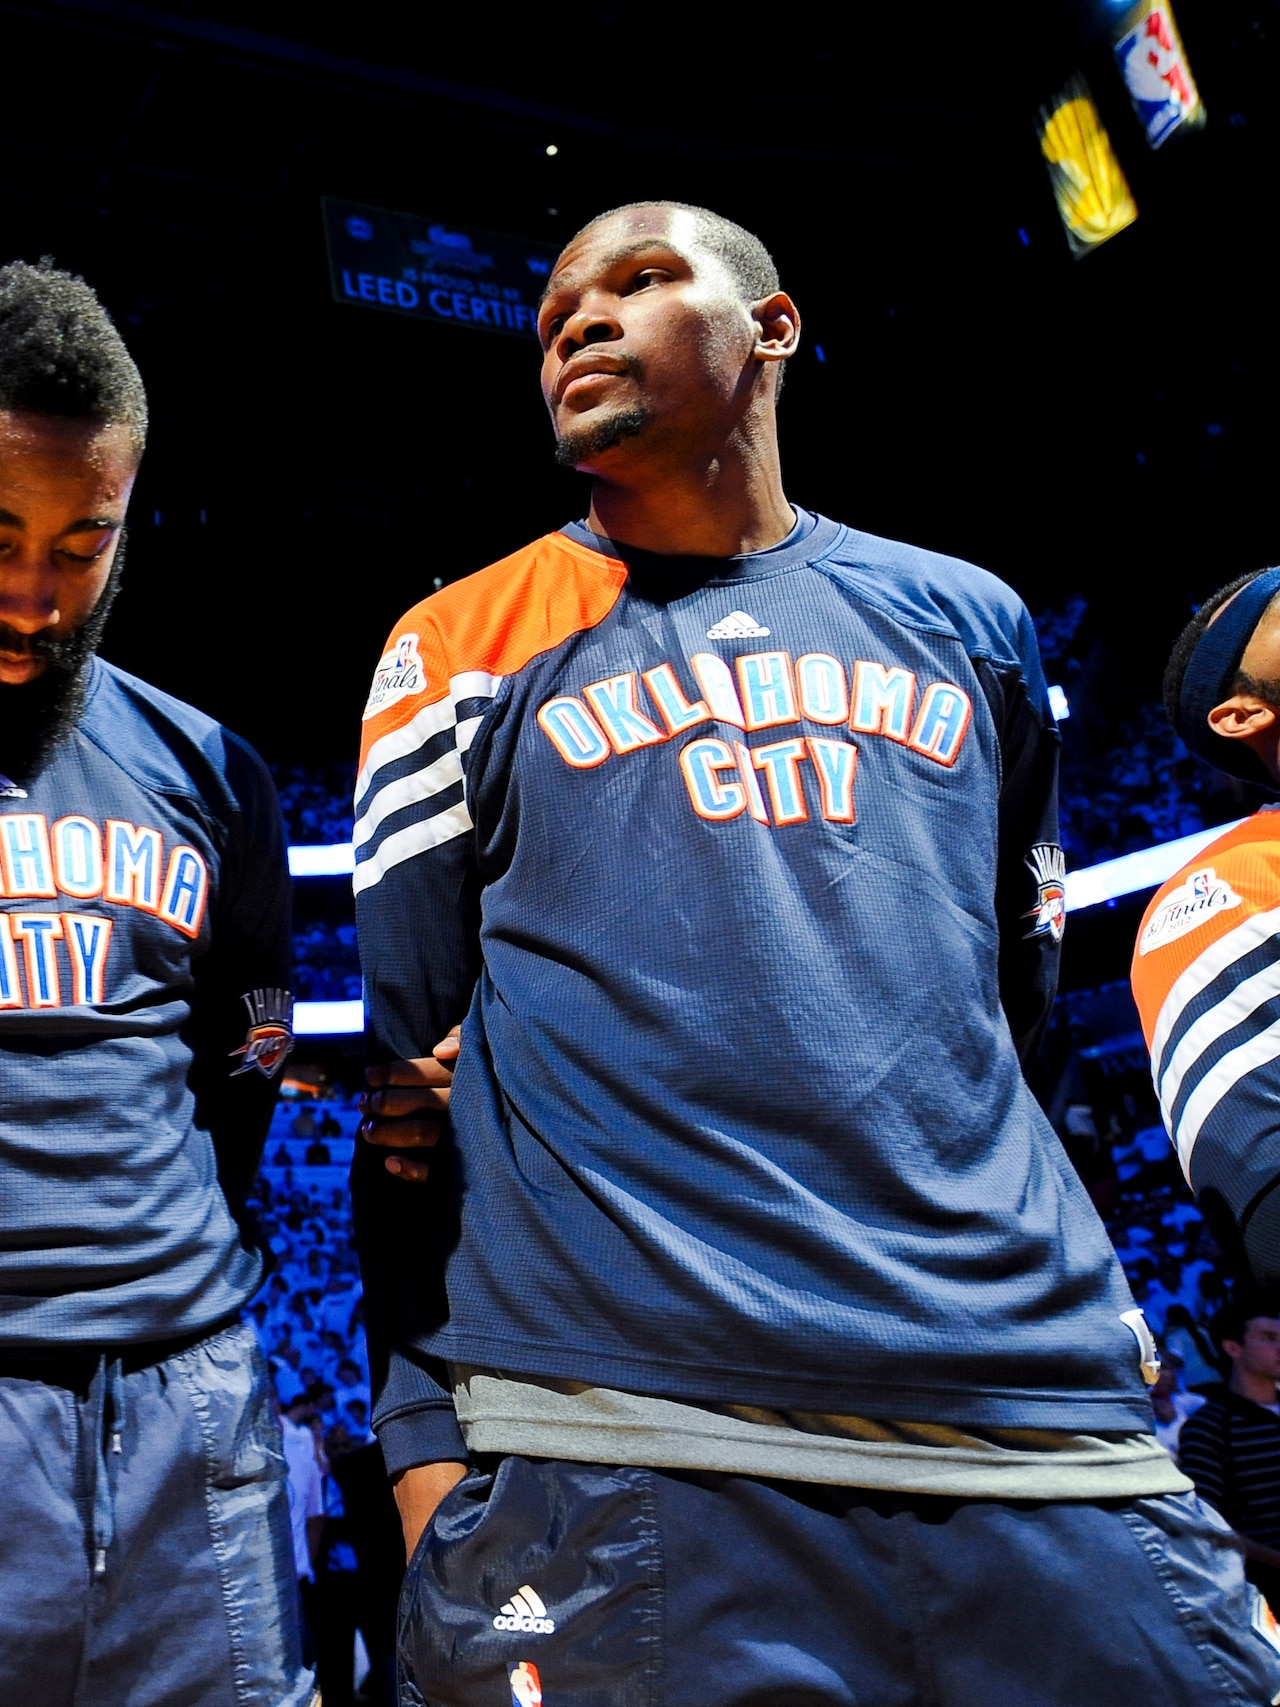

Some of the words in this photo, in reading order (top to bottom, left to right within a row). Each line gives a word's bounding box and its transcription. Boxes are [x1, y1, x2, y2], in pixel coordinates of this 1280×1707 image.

[342, 268, 420, 309] LEED
[536, 650, 972, 769] OKLAHOMA
[679, 736, 858, 827] CITY
[493, 1614, 555, 1634] adidas
